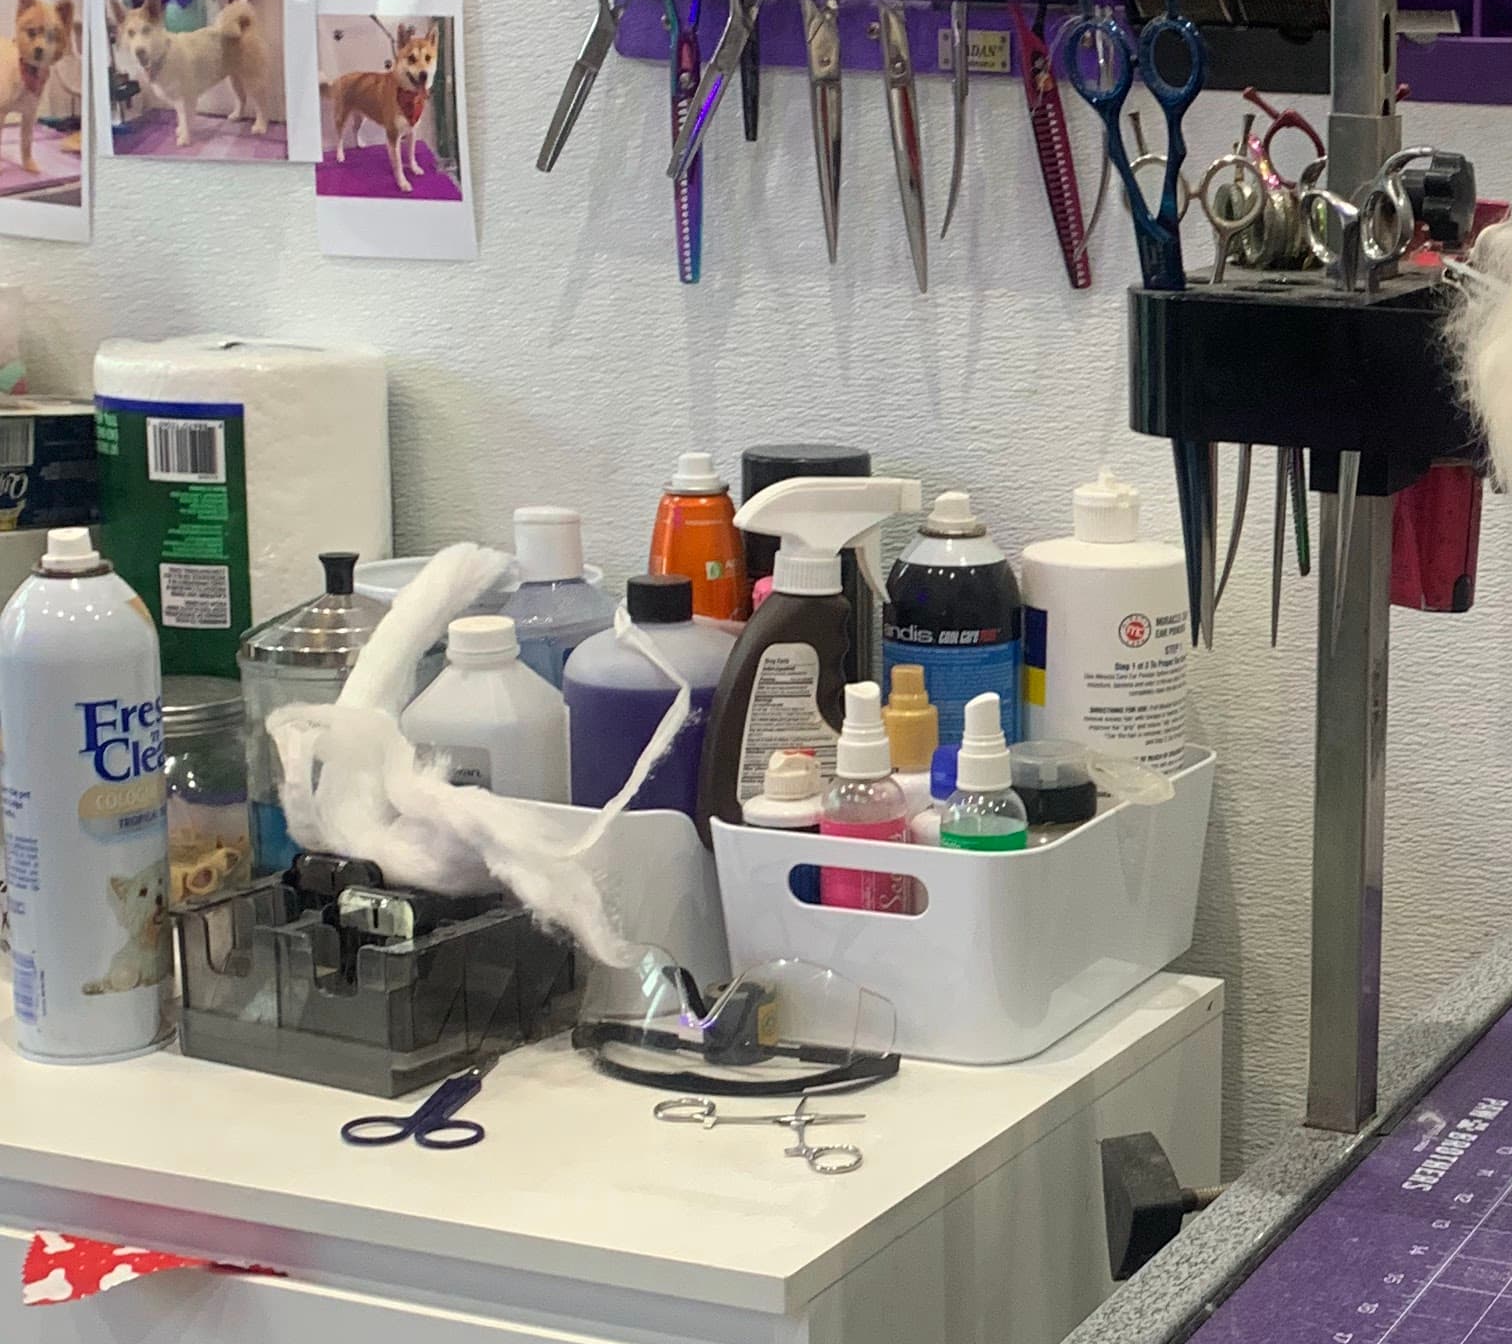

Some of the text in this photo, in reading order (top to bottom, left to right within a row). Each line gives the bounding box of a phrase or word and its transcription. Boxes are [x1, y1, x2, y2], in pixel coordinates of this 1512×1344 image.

[1401, 1131, 1478, 1191] BROTHERS
[1453, 1192, 1474, 1204] 12
[1383, 1272, 1405, 1285] 15
[1332, 1332, 1353, 1344] 17
